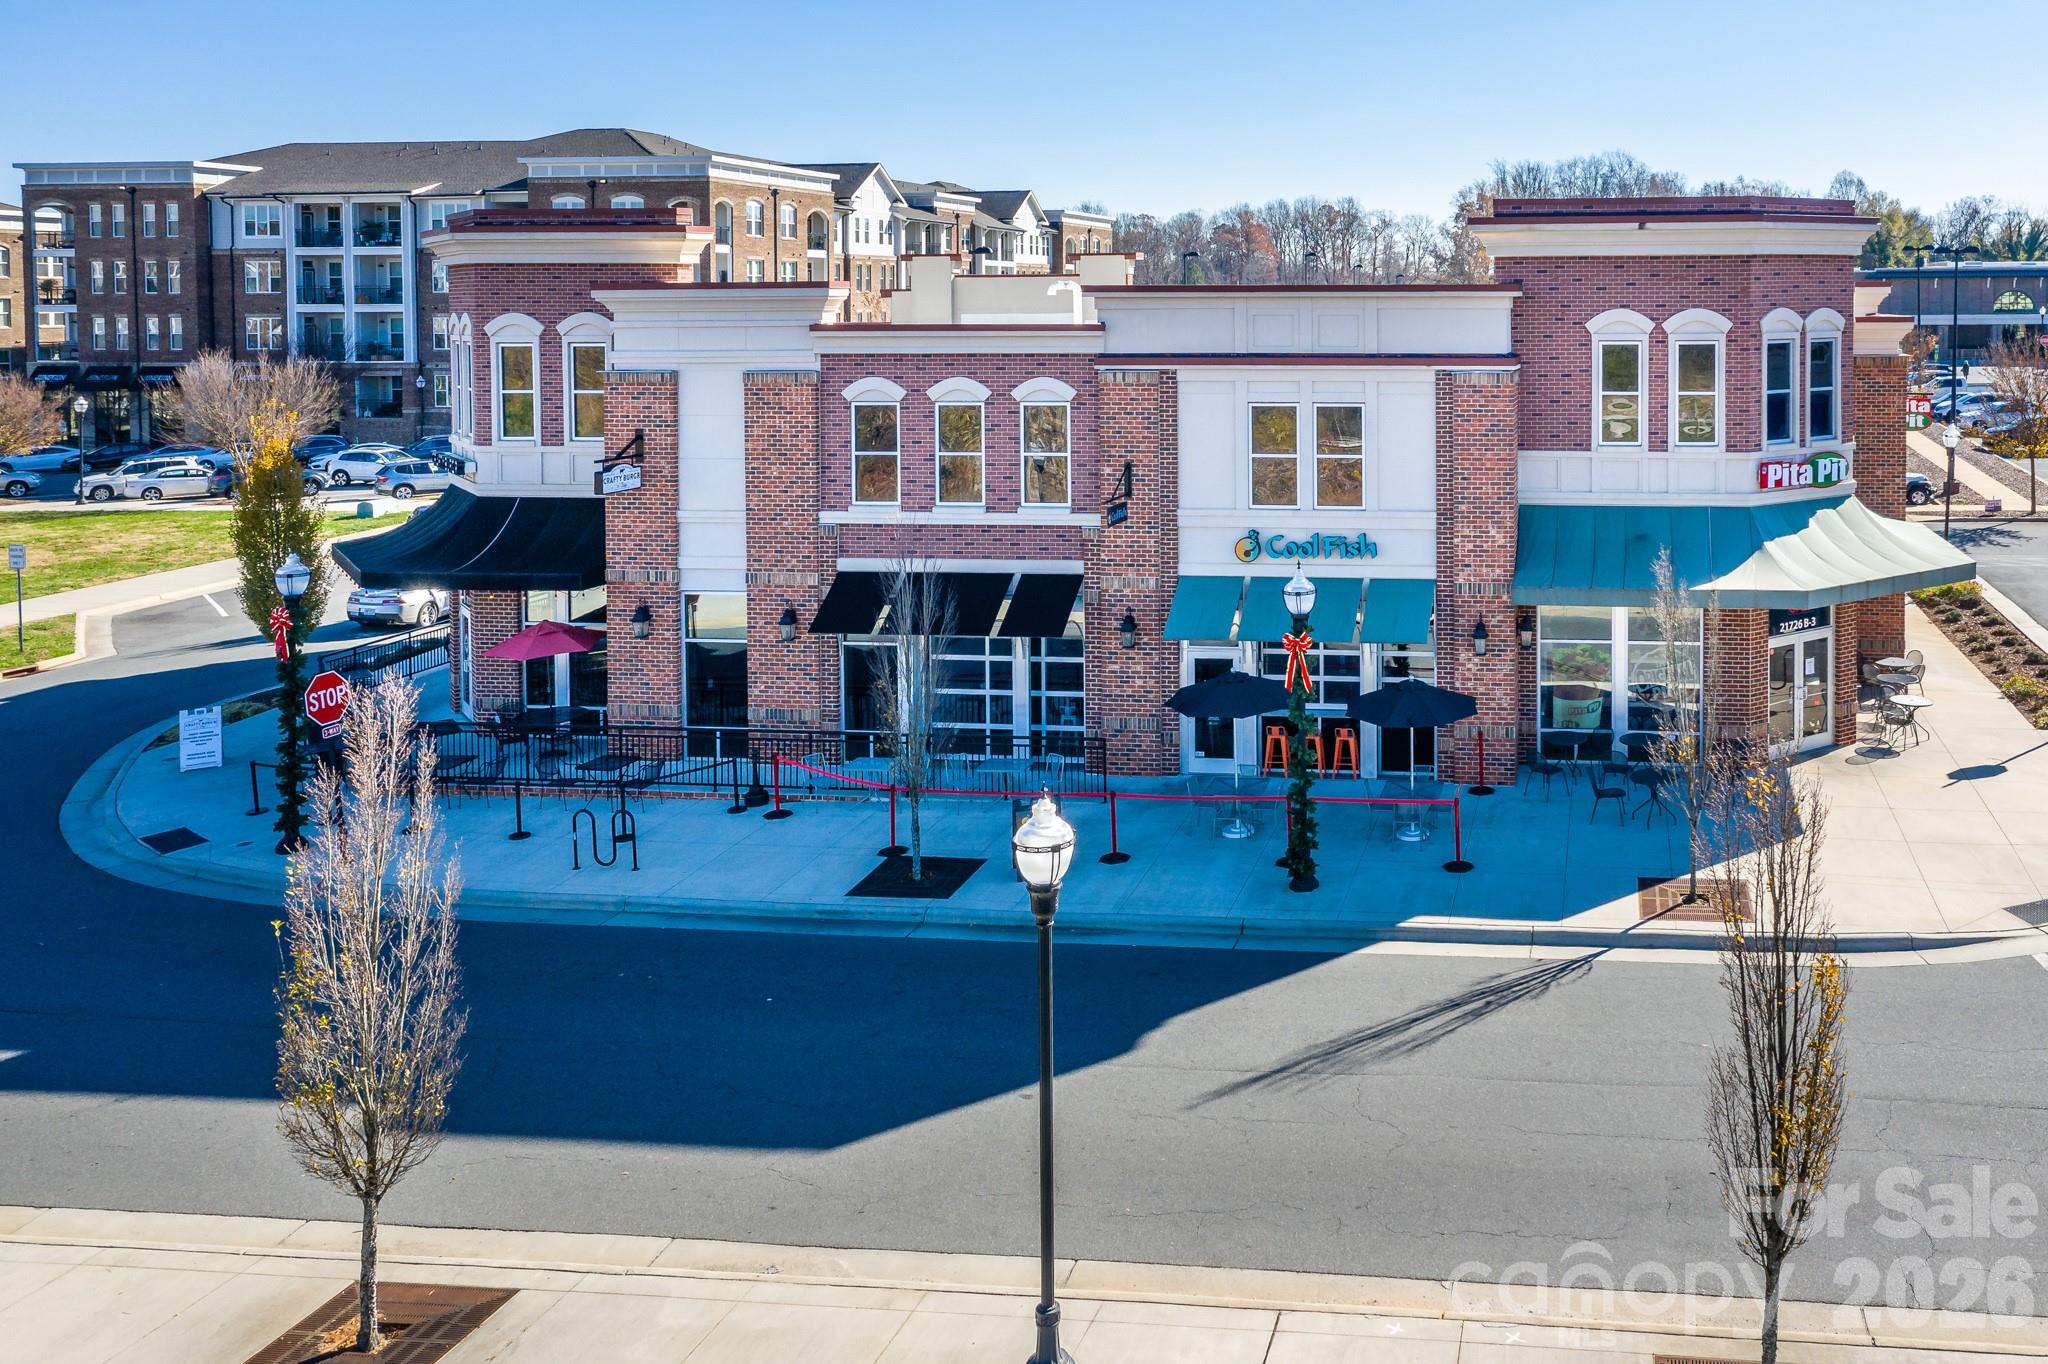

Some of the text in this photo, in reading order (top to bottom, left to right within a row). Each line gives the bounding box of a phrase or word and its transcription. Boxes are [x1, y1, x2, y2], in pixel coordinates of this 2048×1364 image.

[1906, 399, 1930, 412] ita
[603, 475, 623, 485] CRAFTY
[1767, 457, 1847, 488] Pita Pit
[1779, 616, 1816, 633] 21726 B-3
[309, 685, 346, 712] STOP
[324, 727, 339, 737] 3-WAY
